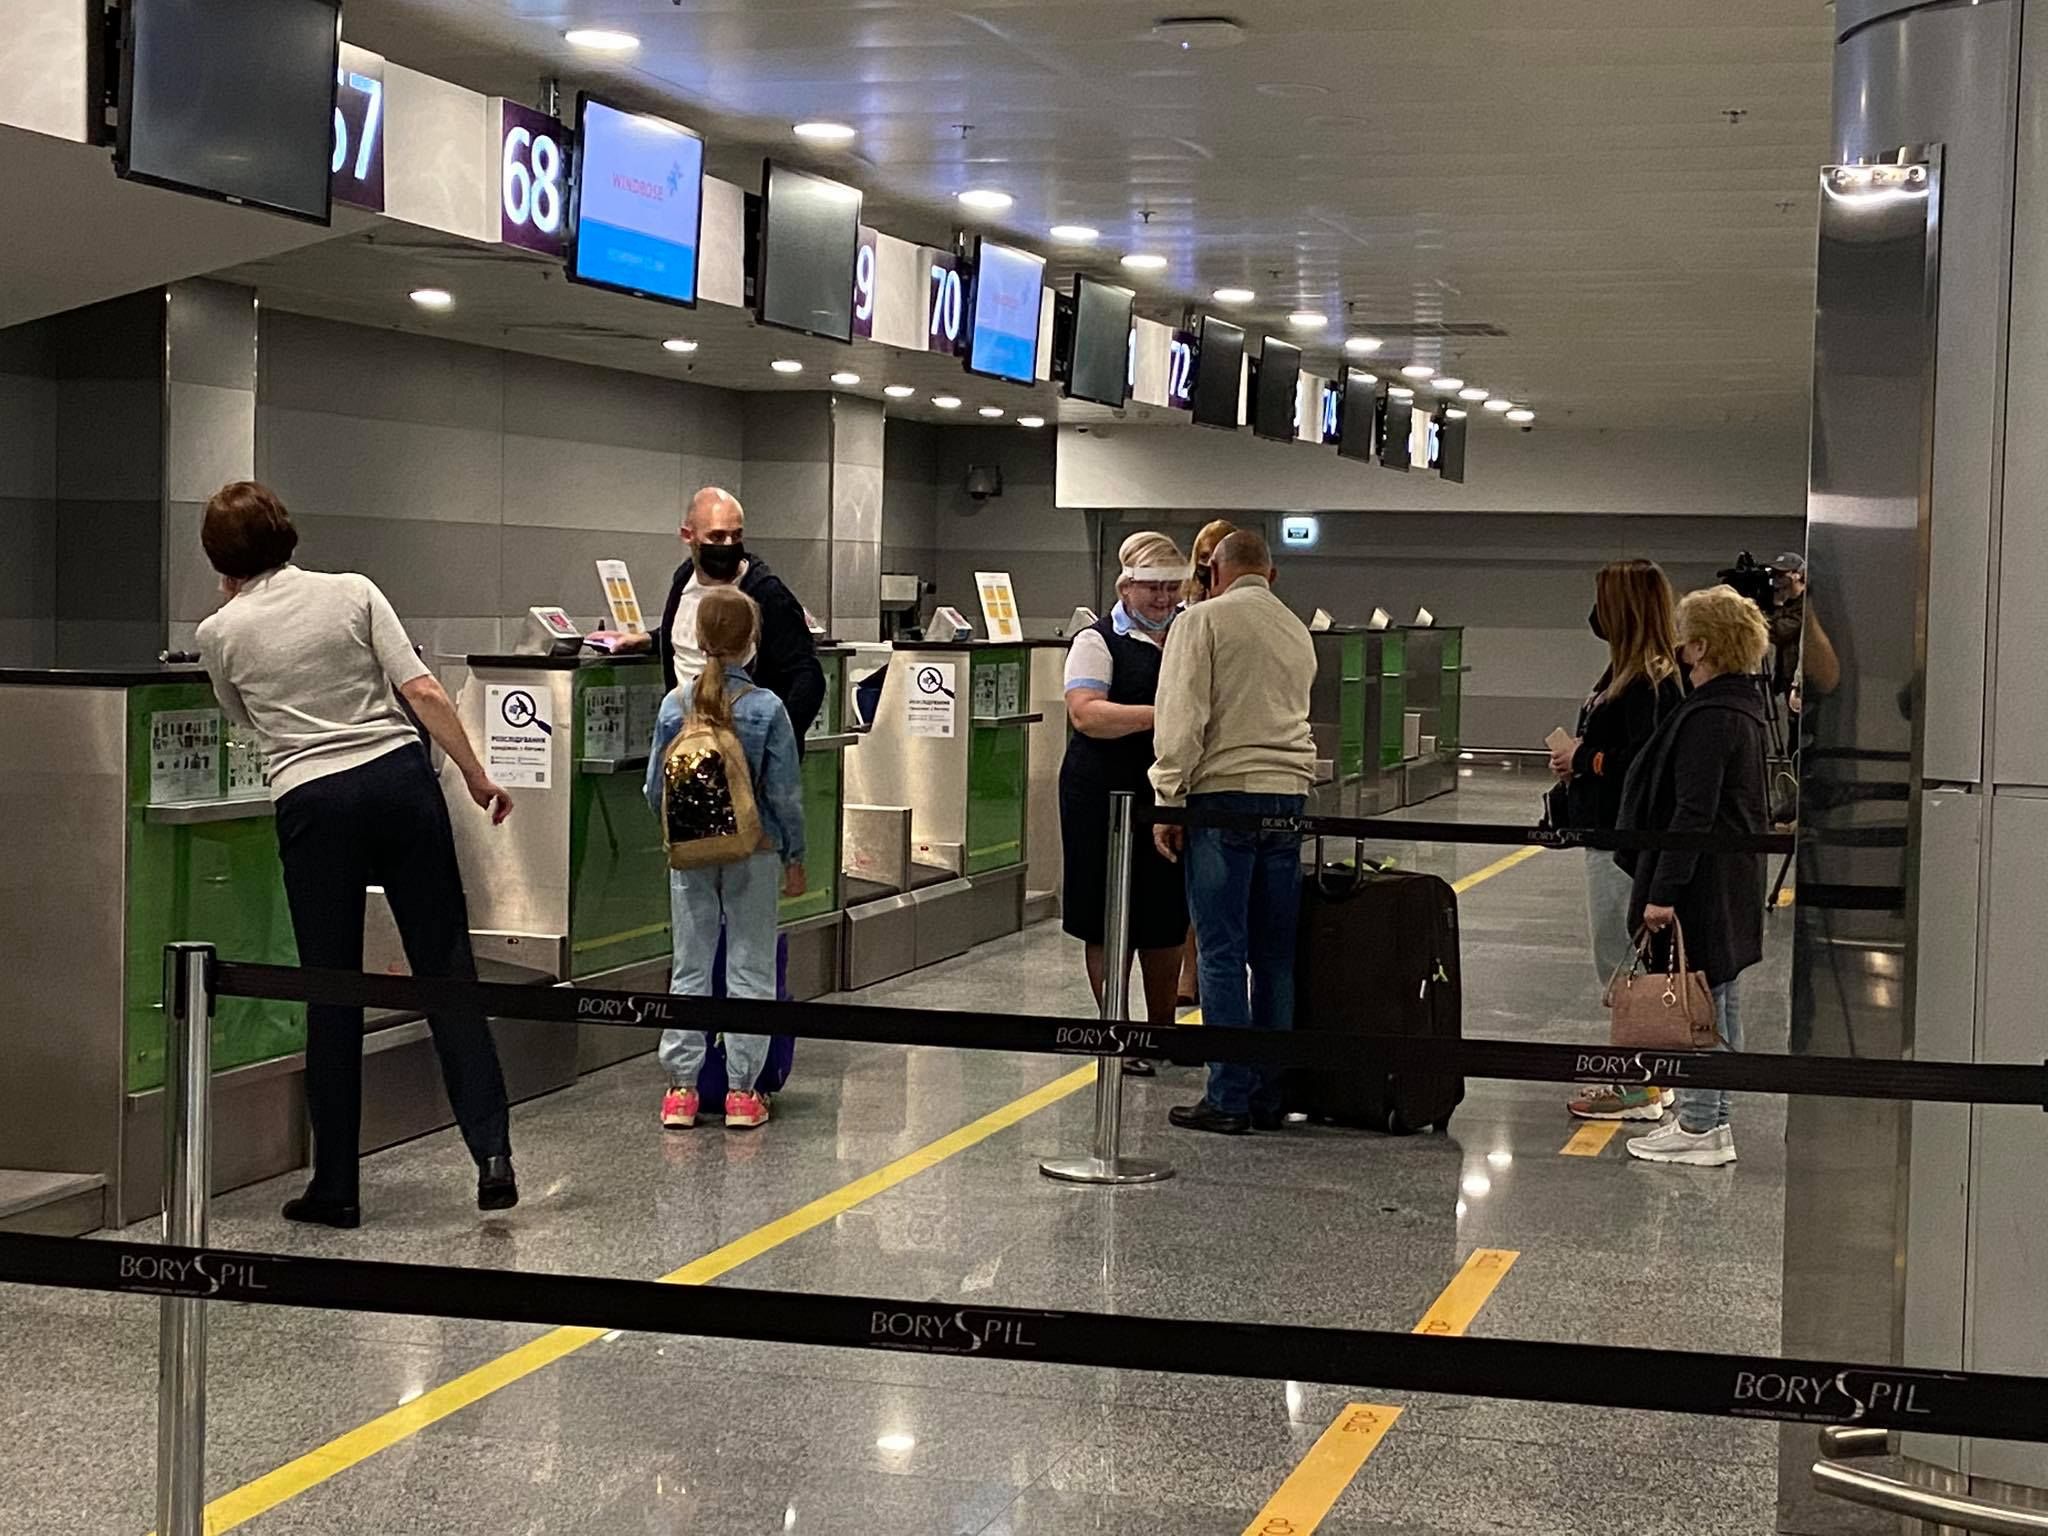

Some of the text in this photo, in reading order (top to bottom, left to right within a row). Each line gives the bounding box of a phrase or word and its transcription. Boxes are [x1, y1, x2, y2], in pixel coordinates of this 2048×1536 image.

[503, 126, 560, 233] 68
[854, 245, 874, 320] 9
[931, 265, 961, 341] 70
[1169, 341, 1191, 398] 72
[578, 996, 673, 1023] BORYSPIL
[1056, 1025, 1159, 1053] BORYSPIL
[1576, 1051, 1690, 1082] BORYSPIL
[120, 1253, 268, 1295] BORYSPIL
[871, 1309, 1036, 1351] BORYSPIL
[1733, 1369, 1931, 1420] BORYSPIL
